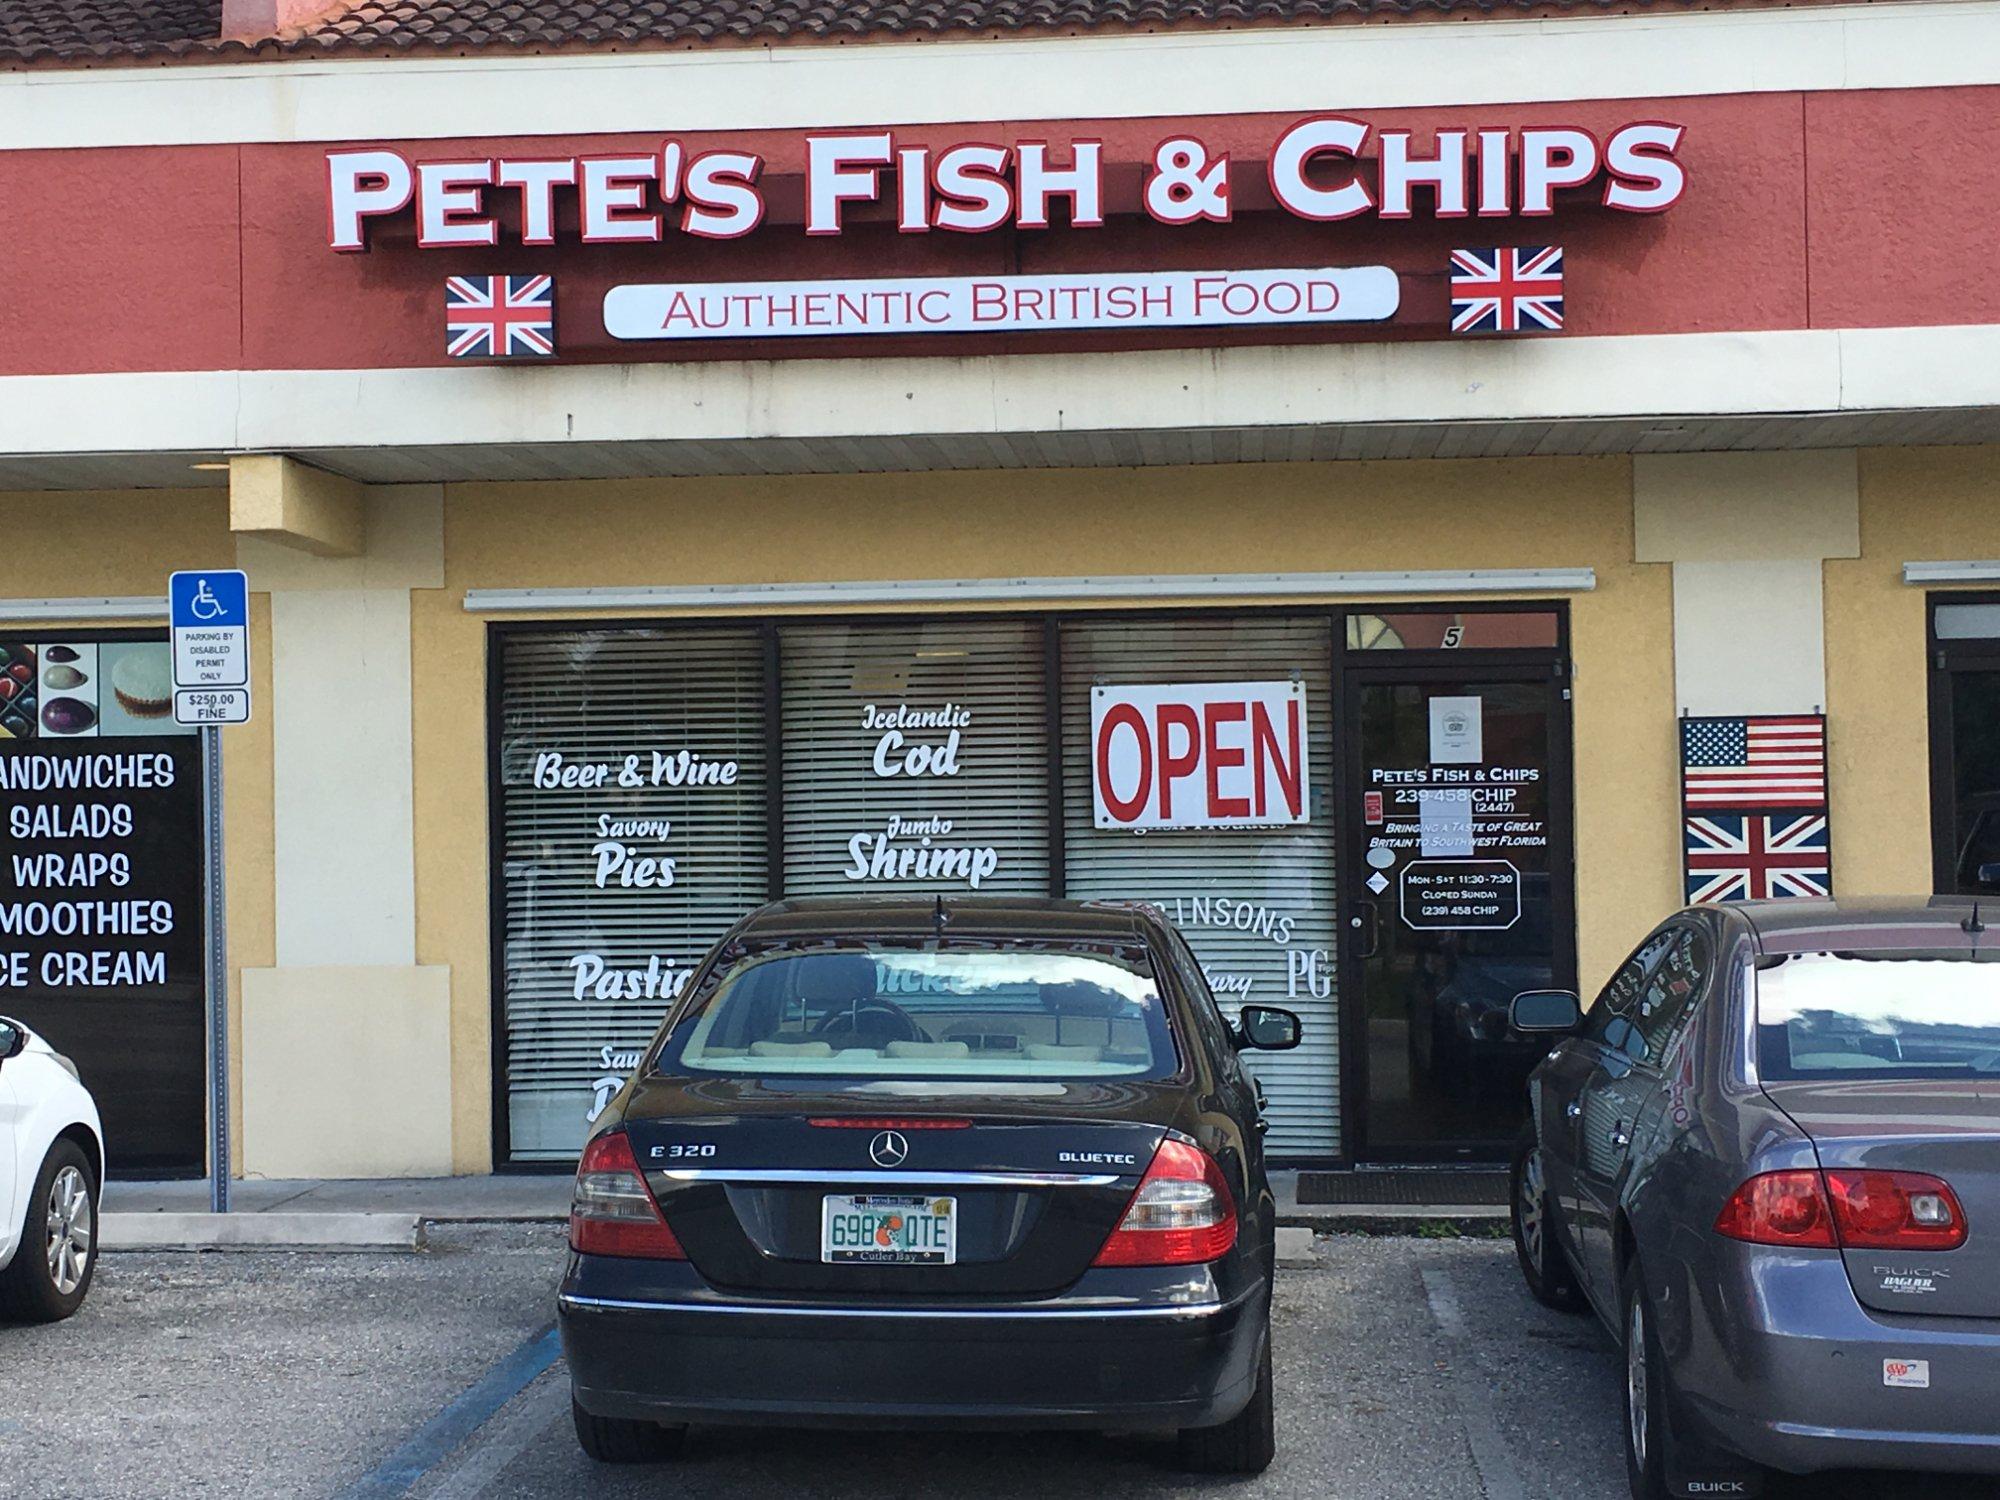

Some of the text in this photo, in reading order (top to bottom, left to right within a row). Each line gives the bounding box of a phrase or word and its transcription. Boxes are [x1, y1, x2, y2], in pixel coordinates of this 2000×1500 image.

[325, 115, 1688, 254] PETE'S FISH & CHIPS
[660, 276, 1341, 332] AUTHENTIC BRITISH FOOD
[185, 632, 234, 641] PARKING BY
[1445, 628, 1460, 647] 5
[190, 646, 230, 654] DISABLED
[195, 659, 224, 668] PERMIT
[200, 672, 221, 680] ONLY
[189, 694, 235, 706] $250.00
[197, 708, 226, 719] FINE
[861, 703, 971, 729] Icelandic
[872, 729, 961, 777] Cod
[1097, 699, 1303, 823] OPEN
[533, 750, 738, 789] Beer & Wine
[1372, 767, 1539, 783] PETE'S FISH & CHIPS
[1475, 802, 1515, 813] (2447)
[10, 803, 133, 839] SALADS
[595, 814, 671, 842] Savory
[887, 814, 952, 839] Jumbo
[1385, 821, 1543, 834] BRINGING A TASTE OF GREAT
[1369, 834, 1547, 848] BRITAIN TO SOUTHWEST FLORIDA
[591, 841, 676, 889] Pies
[844, 832, 998, 889] Shrimp
[12, 852, 130, 888] WRAPS
[1461, 890, 1497, 899] SUNDAY
[1422, 905, 1499, 916] (239) 458 CHIP
[41, 950, 166, 987] CREAM
[1285, 948, 1333, 999] PG
[650, 1145, 717, 1158] E 320
[1058, 1152, 1135, 1164] BLUETEC
[832, 1215, 947, 1247] 698 QTE
[859, 1252, 917, 1264] Cutler Bay
[1688, 1482, 1744, 1491] BUICK
